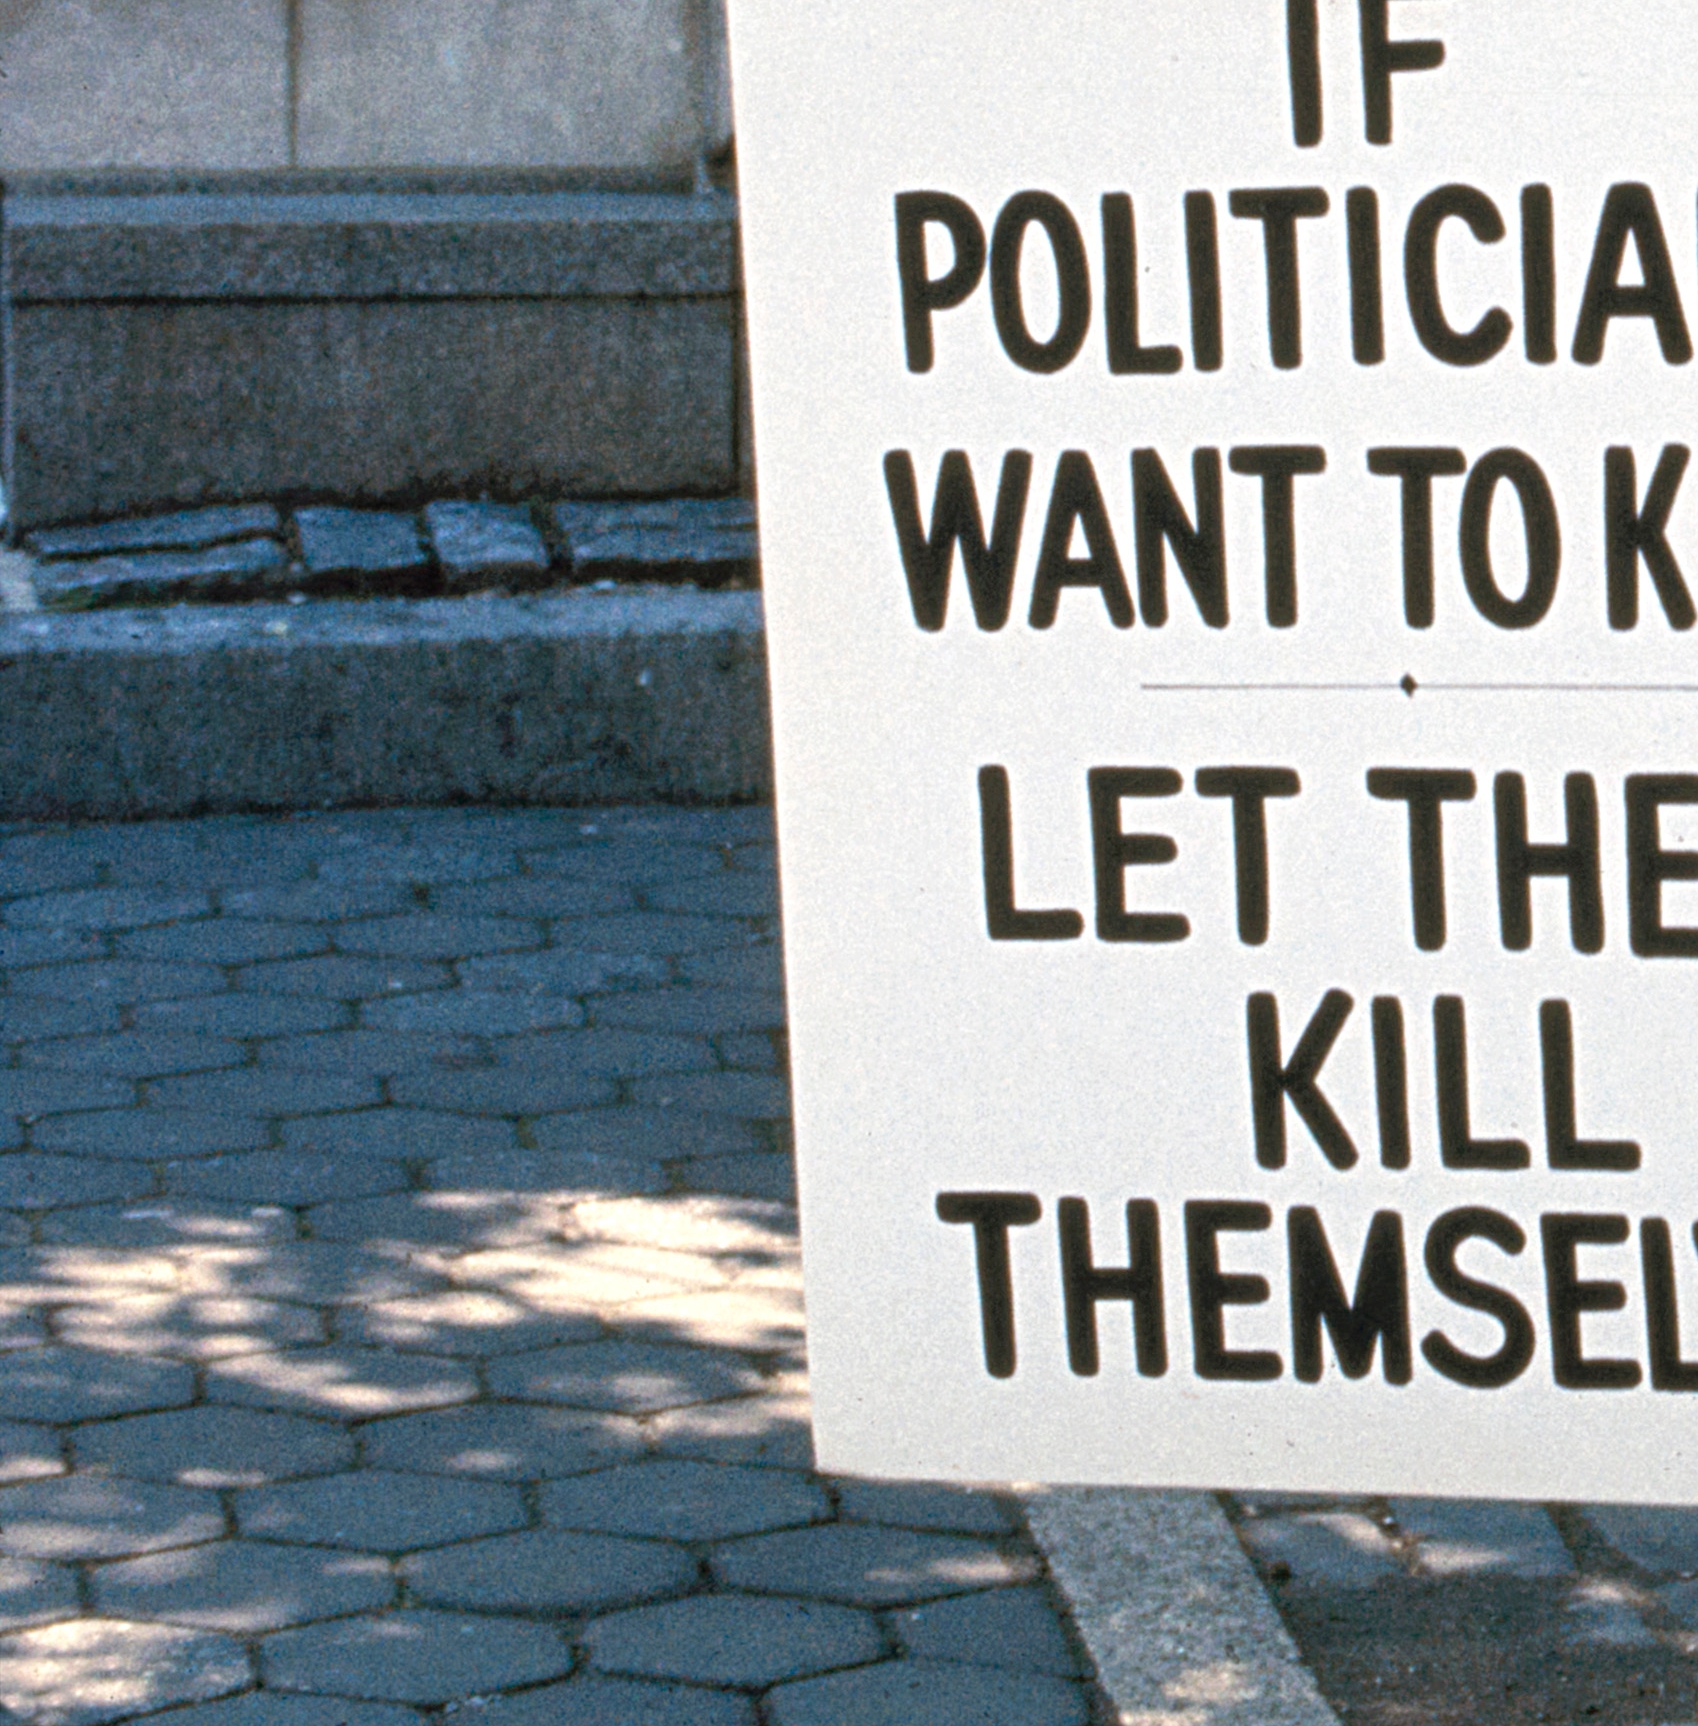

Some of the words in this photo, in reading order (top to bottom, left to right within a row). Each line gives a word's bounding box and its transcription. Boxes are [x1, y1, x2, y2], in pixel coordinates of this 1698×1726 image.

[882, 444, 1327, 633] WANT
[1366, 446, 1562, 630] TO
[977, 764, 1302, 947] LET
[1246, 988, 1642, 1173] KILL
